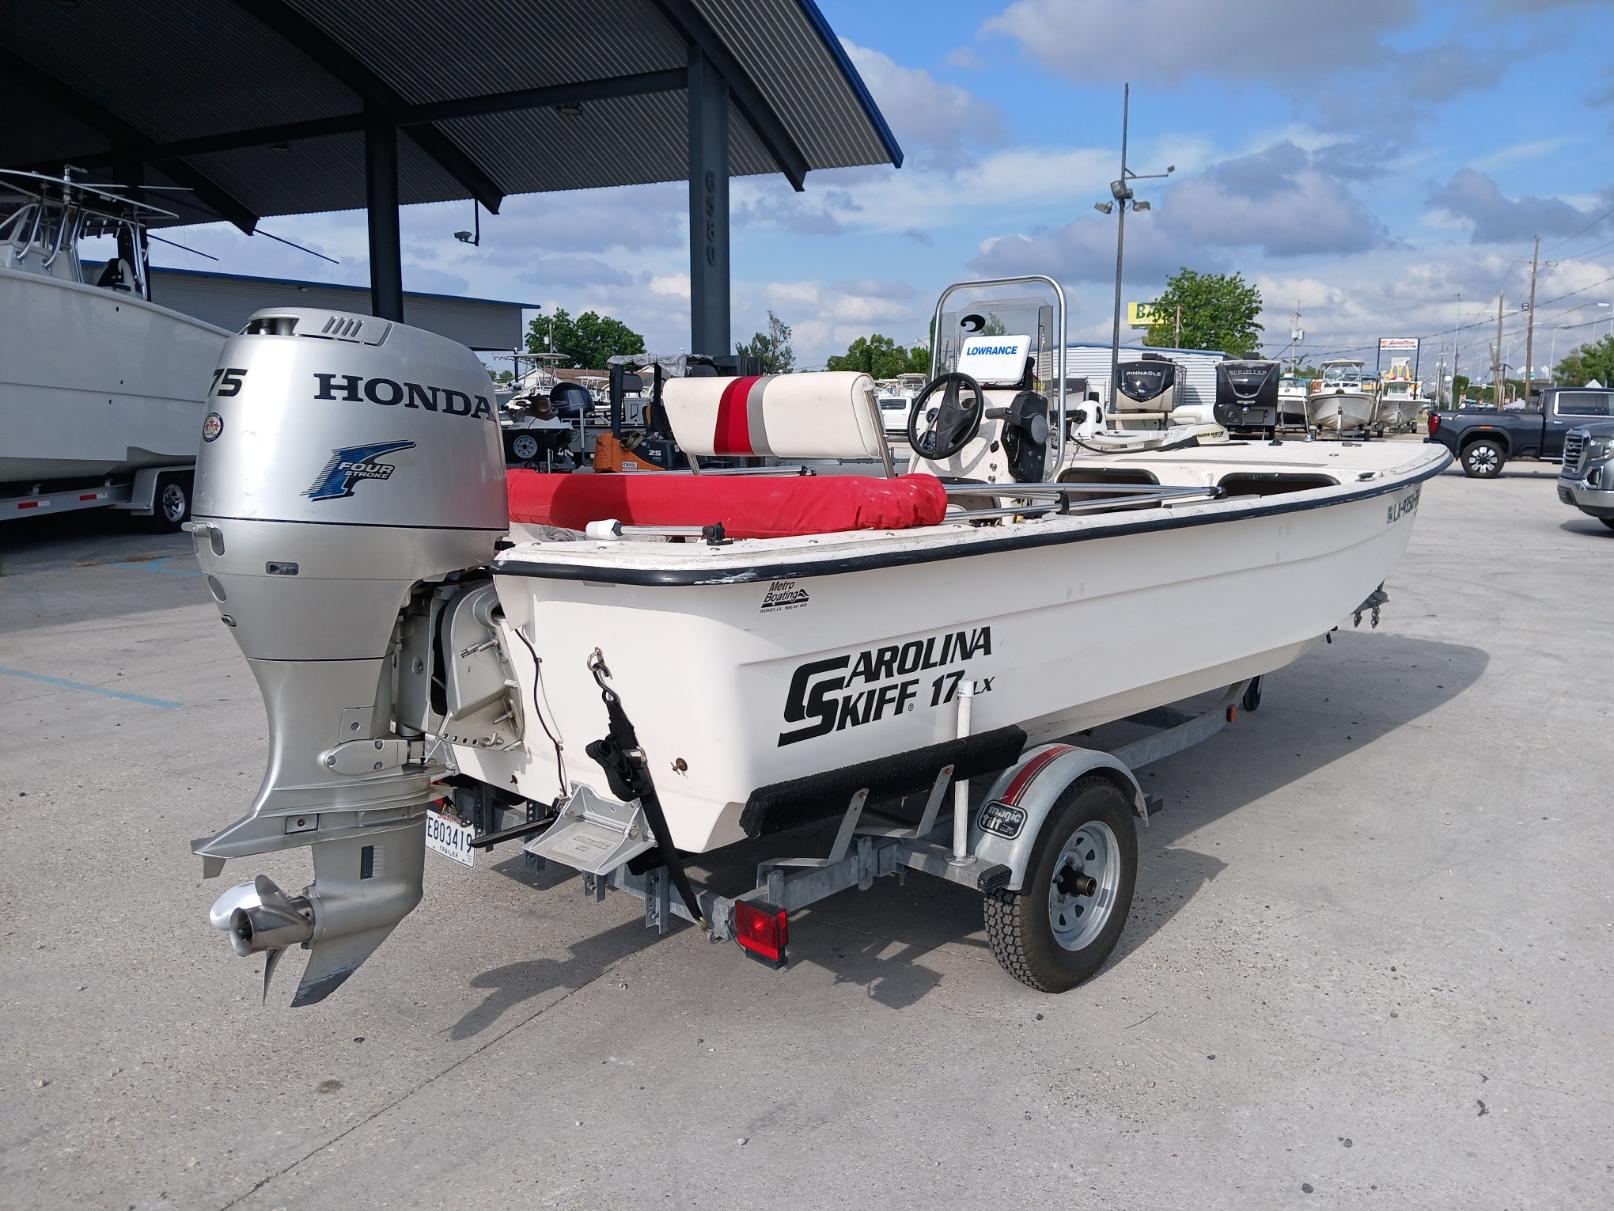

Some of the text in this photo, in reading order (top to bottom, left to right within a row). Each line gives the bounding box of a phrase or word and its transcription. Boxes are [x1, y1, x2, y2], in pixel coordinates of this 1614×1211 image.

[966, 345, 1018, 356] LOWRANCE
[208, 367, 248, 397] 75
[313, 373, 497, 423] HONDA
[338, 462, 394, 474] FOUR
[345, 471, 390, 479] STROKE
[764, 590, 800, 603] Boating
[769, 581, 795, 592] Metro
[784, 626, 992, 723] CAROLINA
[777, 676, 920, 748] SKIFF
[929, 669, 966, 708] 17
[427, 817, 473, 854] E803419
